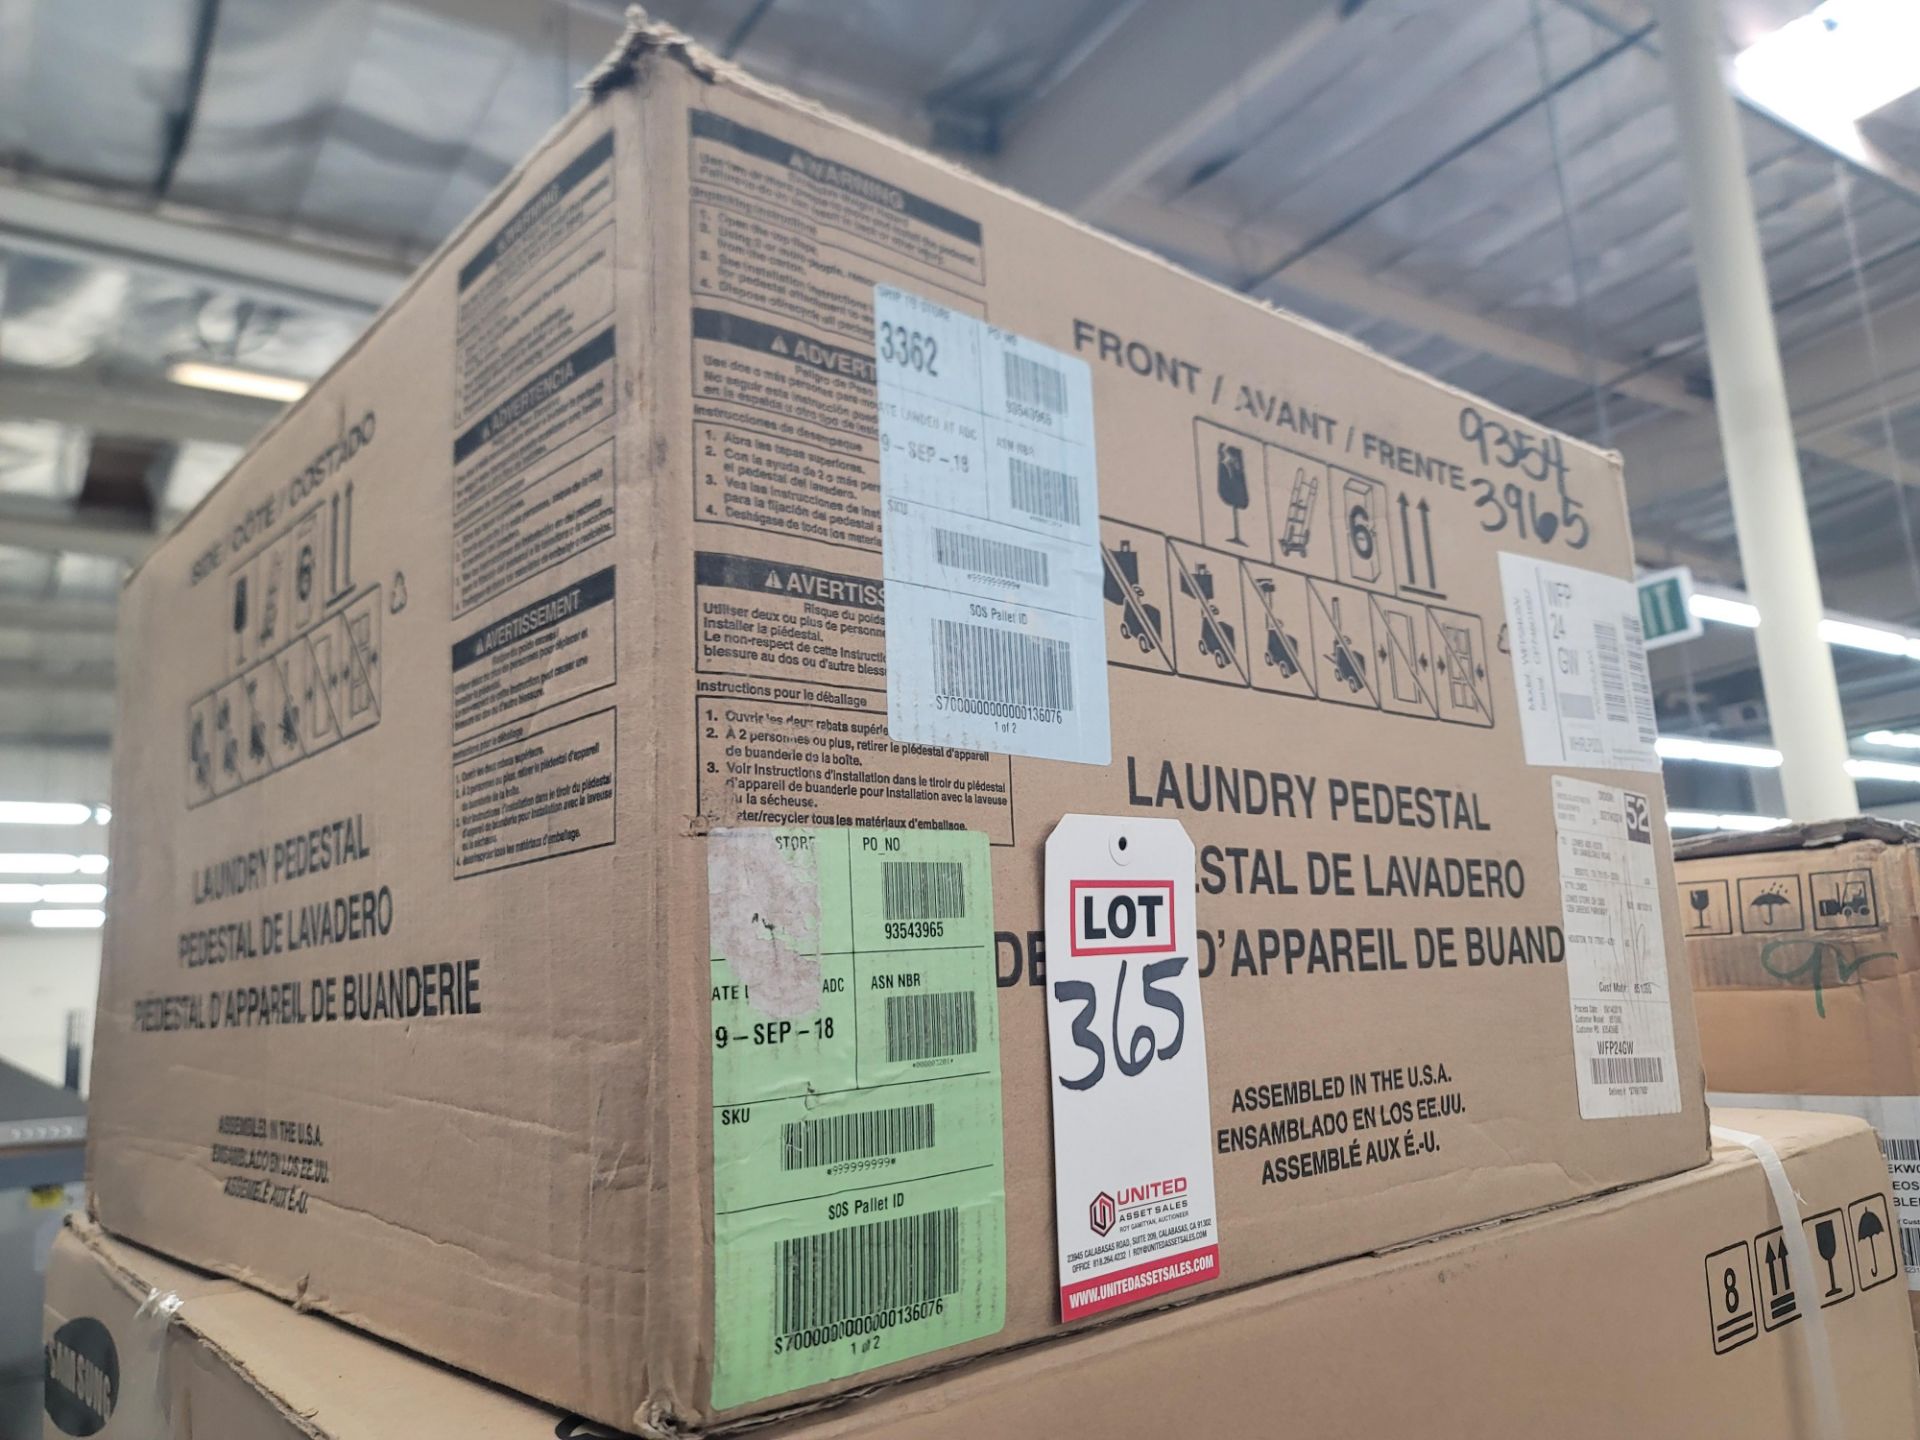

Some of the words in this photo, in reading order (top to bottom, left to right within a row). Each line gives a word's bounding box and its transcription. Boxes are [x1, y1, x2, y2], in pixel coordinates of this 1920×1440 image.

[793, 340, 876, 382] ADVERT
[881, 321, 938, 377] 3362
[1073, 318, 1200, 394] FRONT
[1235, 386, 1337, 446] AVANT
[1363, 434, 1466, 491] FRENTE
[289, 411, 375, 507] COSTADO
[1460, 408, 1569, 496] 9354
[1471, 478, 1590, 550] 3965
[1348, 506, 1373, 560] 6
[787, 572, 884, 607] AVERTISS
[486, 589, 581, 650] AVERTISSEMENT
[704, 602, 748, 617] Utiliser
[751, 607, 779, 621] deux
[800, 616, 822, 629] plus
[804, 603, 838, 618] Risque
[970, 603, 988, 618] SOS
[991, 608, 1016, 623] Pallet
[1019, 614, 1027, 625] ID
[704, 631, 720, 643] Le
[724, 634, 793, 651] non-respect
[771, 625, 823, 642] piédestal.
[704, 645, 758, 660] blessure
[761, 651, 775, 662] au
[778, 653, 799, 665] dos
[802, 657, 816, 668] ou
[819, 659, 855, 672] d'autre
[697, 680, 771, 697] Instructions
[774, 687, 800, 700] pour
[817, 692, 867, 708] déballage
[817, 720, 848, 732] rabats
[1002, 722, 1009, 733] of
[1012, 723, 1016, 733] 2
[726, 746, 741, 756] de
[745, 746, 802, 761] buanderie
[805, 751, 818, 762] de
[739, 729, 747, 739] 2
[813, 736, 826, 746] ou
[829, 738, 854, 750] plus,
[857, 741, 887, 752] retirer
[902, 744, 944, 758] piédestal
[946, 748, 989, 762] d'appareil
[726, 761, 751, 775] Voir
[824, 767, 890, 785] d'installation
[893, 775, 916, 785] dans
[930, 777, 951, 788] tiroir
[954, 779, 965, 790] du
[967, 780, 1005, 793] piédestal
[760, 794, 817, 808] sécheuse.
[788, 781, 802, 791] de
[805, 782, 857, 797] buanderie
[860, 785, 887, 798] pour
[941, 792, 962, 802] avec
[975, 794, 1007, 806] laveuse
[1127, 756, 1316, 819] LAUNDRY
[1330, 778, 1490, 831] PEDESTAL
[811, 813, 835, 825] tous
[836, 814, 852, 826] les
[855, 816, 906, 828] matériaux
[1625, 796, 1649, 833] 52
[193, 848, 268, 905] LAUNDRY
[274, 814, 370, 884] PEDESTAL
[775, 836, 816, 851] STOR
[1196, 846, 1298, 895] STAL
[1307, 851, 1355, 895] DE
[1364, 853, 1524, 899] LAVADERO
[178, 920, 257, 968] PEDESTAL
[263, 913, 283, 955] DE
[288, 885, 393, 951] LAVADERO
[885, 922, 943, 939] 93543965
[1084, 895, 1163, 939] LOT
[1197, 928, 1407, 978] D'APPAREIL
[1415, 928, 1455, 969] DE
[1466, 925, 1565, 967] BUAND
[134, 995, 206, 1032] PEDESTAL
[210, 981, 306, 1028] D'APPAREIL
[312, 977, 337, 1021] DE
[343, 958, 481, 1020] BUANDERIE
[871, 975, 894, 990] ASN
[897, 974, 920, 988] NBR
[1054, 957, 1189, 1091] 365
[1597, 1040, 1634, 1055] WFP24GW
[1232, 1076, 1344, 1113] ASSEMBLED
[1350, 1073, 1367, 1096] IN
[1371, 1068, 1403, 1093] THE
[1407, 1063, 1452, 1087] U.S.A.
[280, 1120, 296, 1142] THE
[298, 1122, 323, 1146] U.S.A.
[722, 1109, 750, 1125] SKU
[1218, 1111, 1348, 1153] ENSAMBLADO
[1354, 1107, 1376, 1130] EN
[1380, 1101, 1413, 1126] LOS
[1417, 1093, 1465, 1120] EE.UU.
[1262, 1139, 1362, 1185] ASSEMBLÉ
[1366, 1137, 1401, 1165] AUX
[829, 1202, 848, 1220] SOS
[854, 1197, 888, 1214] Pallet
[893, 1193, 904, 1207] ID
[1117, 1177, 1187, 1205] UNITED
[1119, 1208, 1152, 1222] ASSET
[1155, 1200, 1188, 1214] SALES
[1120, 1225, 1130, 1233] ROY
[1159, 1211, 1189, 1223] AUCTIONEER
[1072, 1262, 1090, 1273] OFFICE
[1133, 1230, 1207, 1256] ROY@UNITEDASSETSALES.COM
[1084, 1242, 1115, 1258] CALABASAS
[1116, 1239, 1131, 1250] ROAD,
[1132, 1234, 1146, 1246] SUITE
[1159, 1224, 1188, 1239] CALABASAS,
[1189, 1222, 1196, 1231] CA
[1197, 1219, 1211, 1229] 91302
[1069, 1254, 1214, 1309] WWW.UNITEDASSETSALES.COM
[851, 1342, 856, 1355] 1
[862, 1339, 870, 1352] of
[874, 1337, 880, 1349] 2
